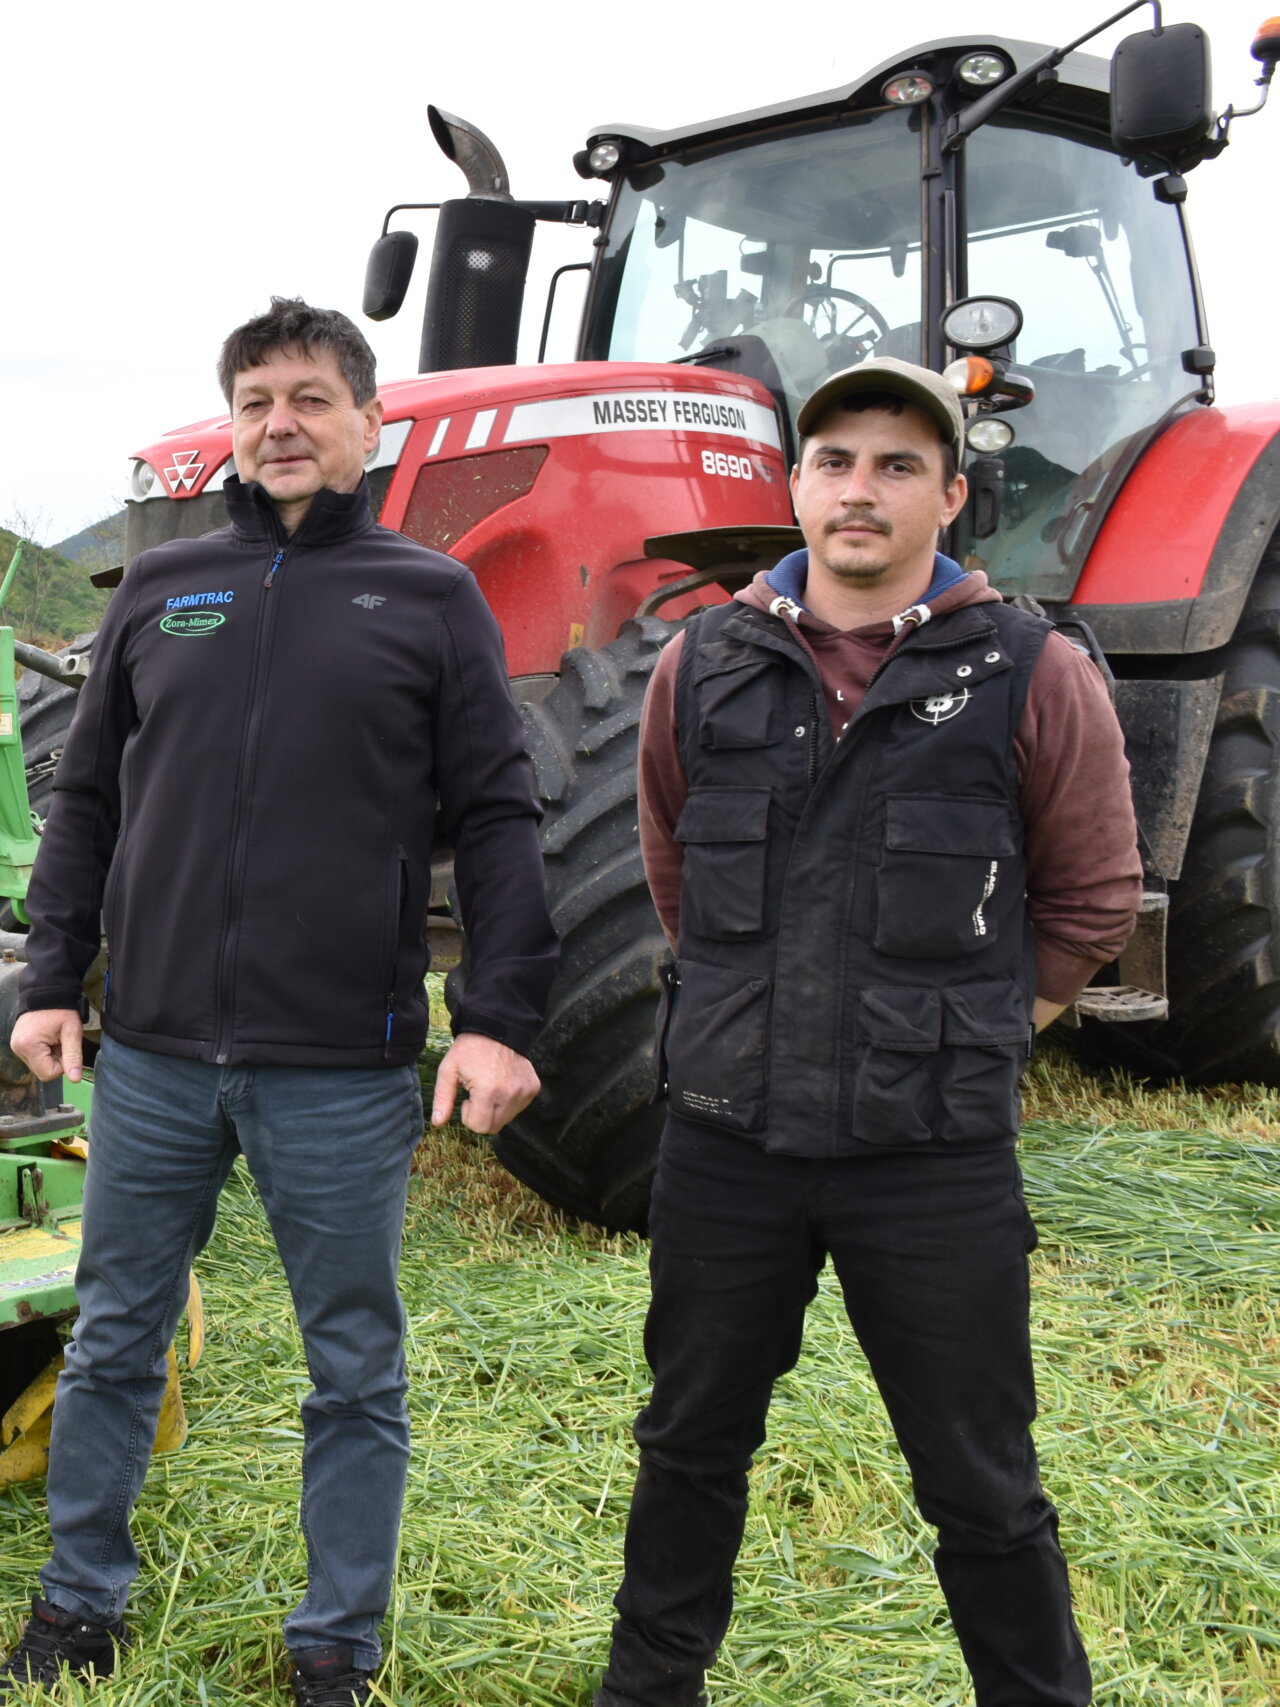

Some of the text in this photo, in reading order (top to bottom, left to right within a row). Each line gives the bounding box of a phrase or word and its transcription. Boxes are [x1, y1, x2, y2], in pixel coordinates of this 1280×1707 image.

[593, 399, 747, 431] MASSEY FERGUSON
[701, 450, 753, 481] 8690
[166, 590, 234, 611] FARMTRAC
[351, 593, 387, 610] 4F
[165, 617, 218, 629] Zora-Mimex
